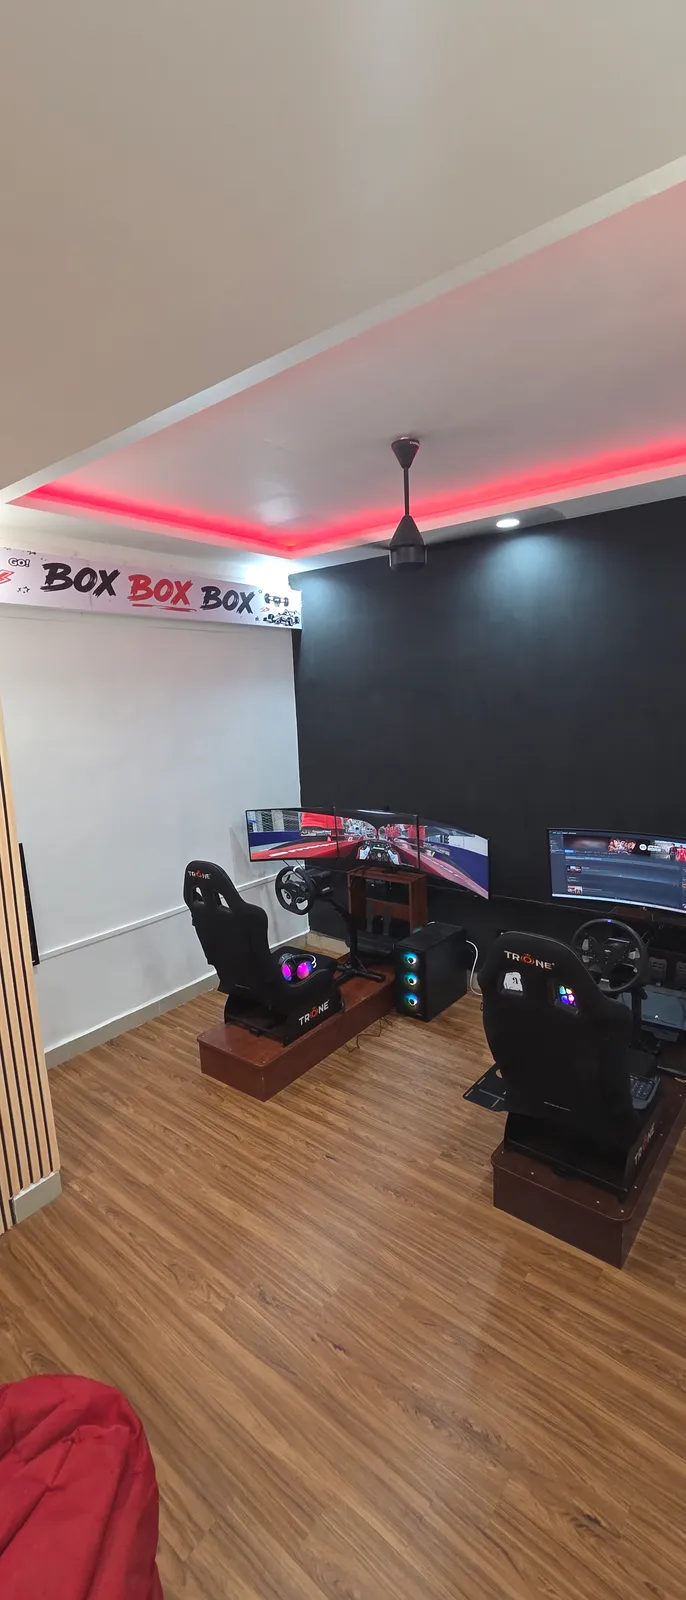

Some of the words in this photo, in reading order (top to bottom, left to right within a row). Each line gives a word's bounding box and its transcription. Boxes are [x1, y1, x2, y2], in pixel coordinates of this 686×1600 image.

[8, 558, 31, 567] GO!
[40, 563, 121, 598] BOX
[127, 574, 194, 606] BOX
[200, 585, 256, 614] BOX
